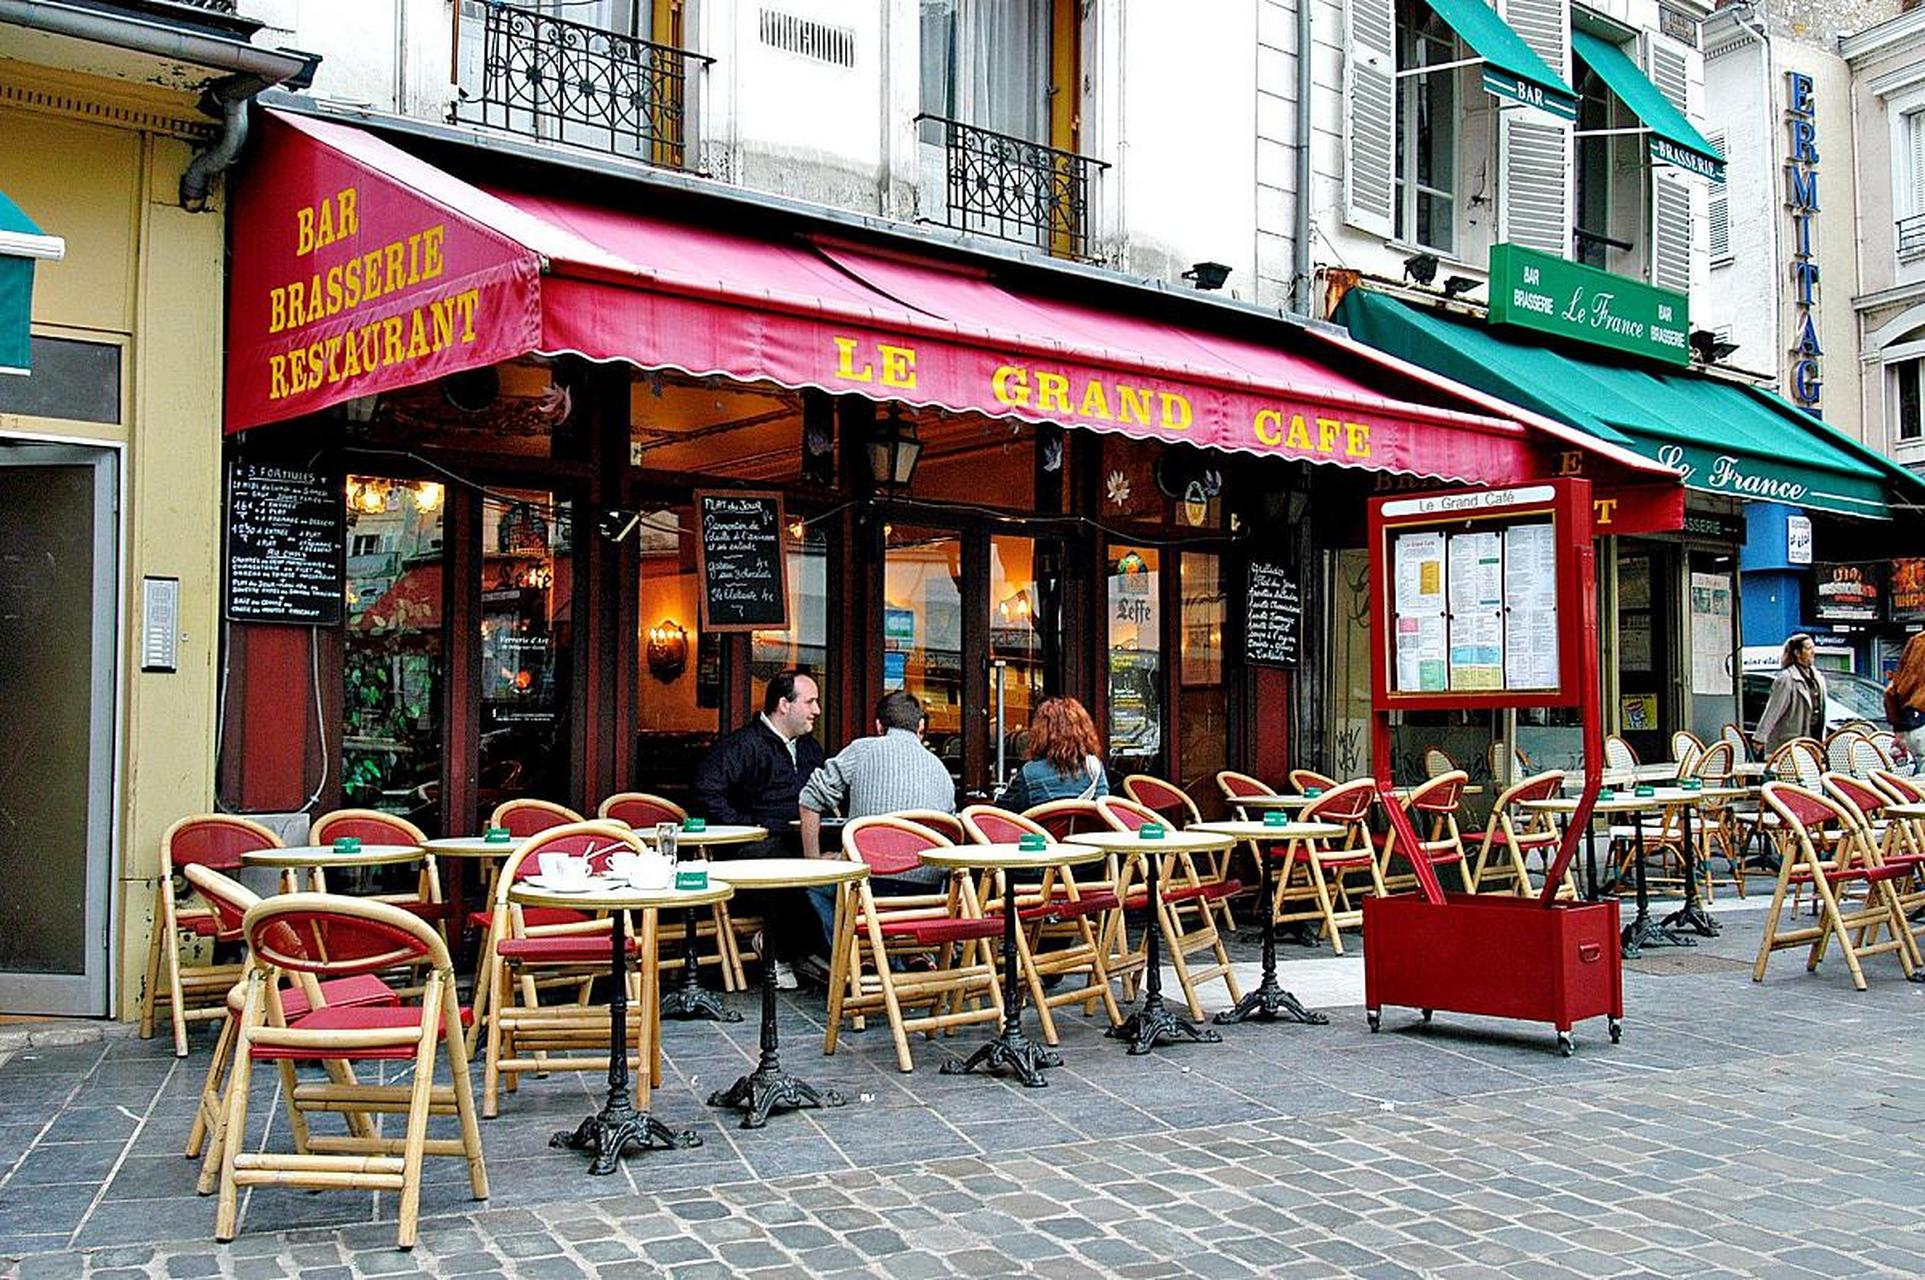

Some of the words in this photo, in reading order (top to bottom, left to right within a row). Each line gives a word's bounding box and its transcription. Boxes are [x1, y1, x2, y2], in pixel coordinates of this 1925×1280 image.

[1517, 81, 1544, 107] BAR
[1658, 140, 1716, 178] BRASSERIE
[297, 187, 359, 257] BAR
[1788, 71, 1822, 420] ERMITAG
[269, 225, 444, 334] BRASSERIE
[1523, 266, 1540, 287] BAR
[1514, 288, 1554, 315] BRASSERIE
[1561, 286, 1586, 323] Le
[1590, 292, 1644, 338] France
[1657, 304, 1673, 323] BAR
[269, 289, 479, 399] RESTAURANT
[1650, 325, 1686, 349] BRASSERIE
[834, 337, 917, 389] LE
[992, 366, 1194, 431] GRAND
[1253, 410, 1373, 459] CAFE
[1658, 445, 1697, 483] Le
[1708, 455, 1808, 500] France
[1419, 500, 1434, 512] Le
[1441, 496, 1478, 510] Grand
[1485, 490, 1515, 505] Café
[1116, 598, 1151, 624] Leffe
